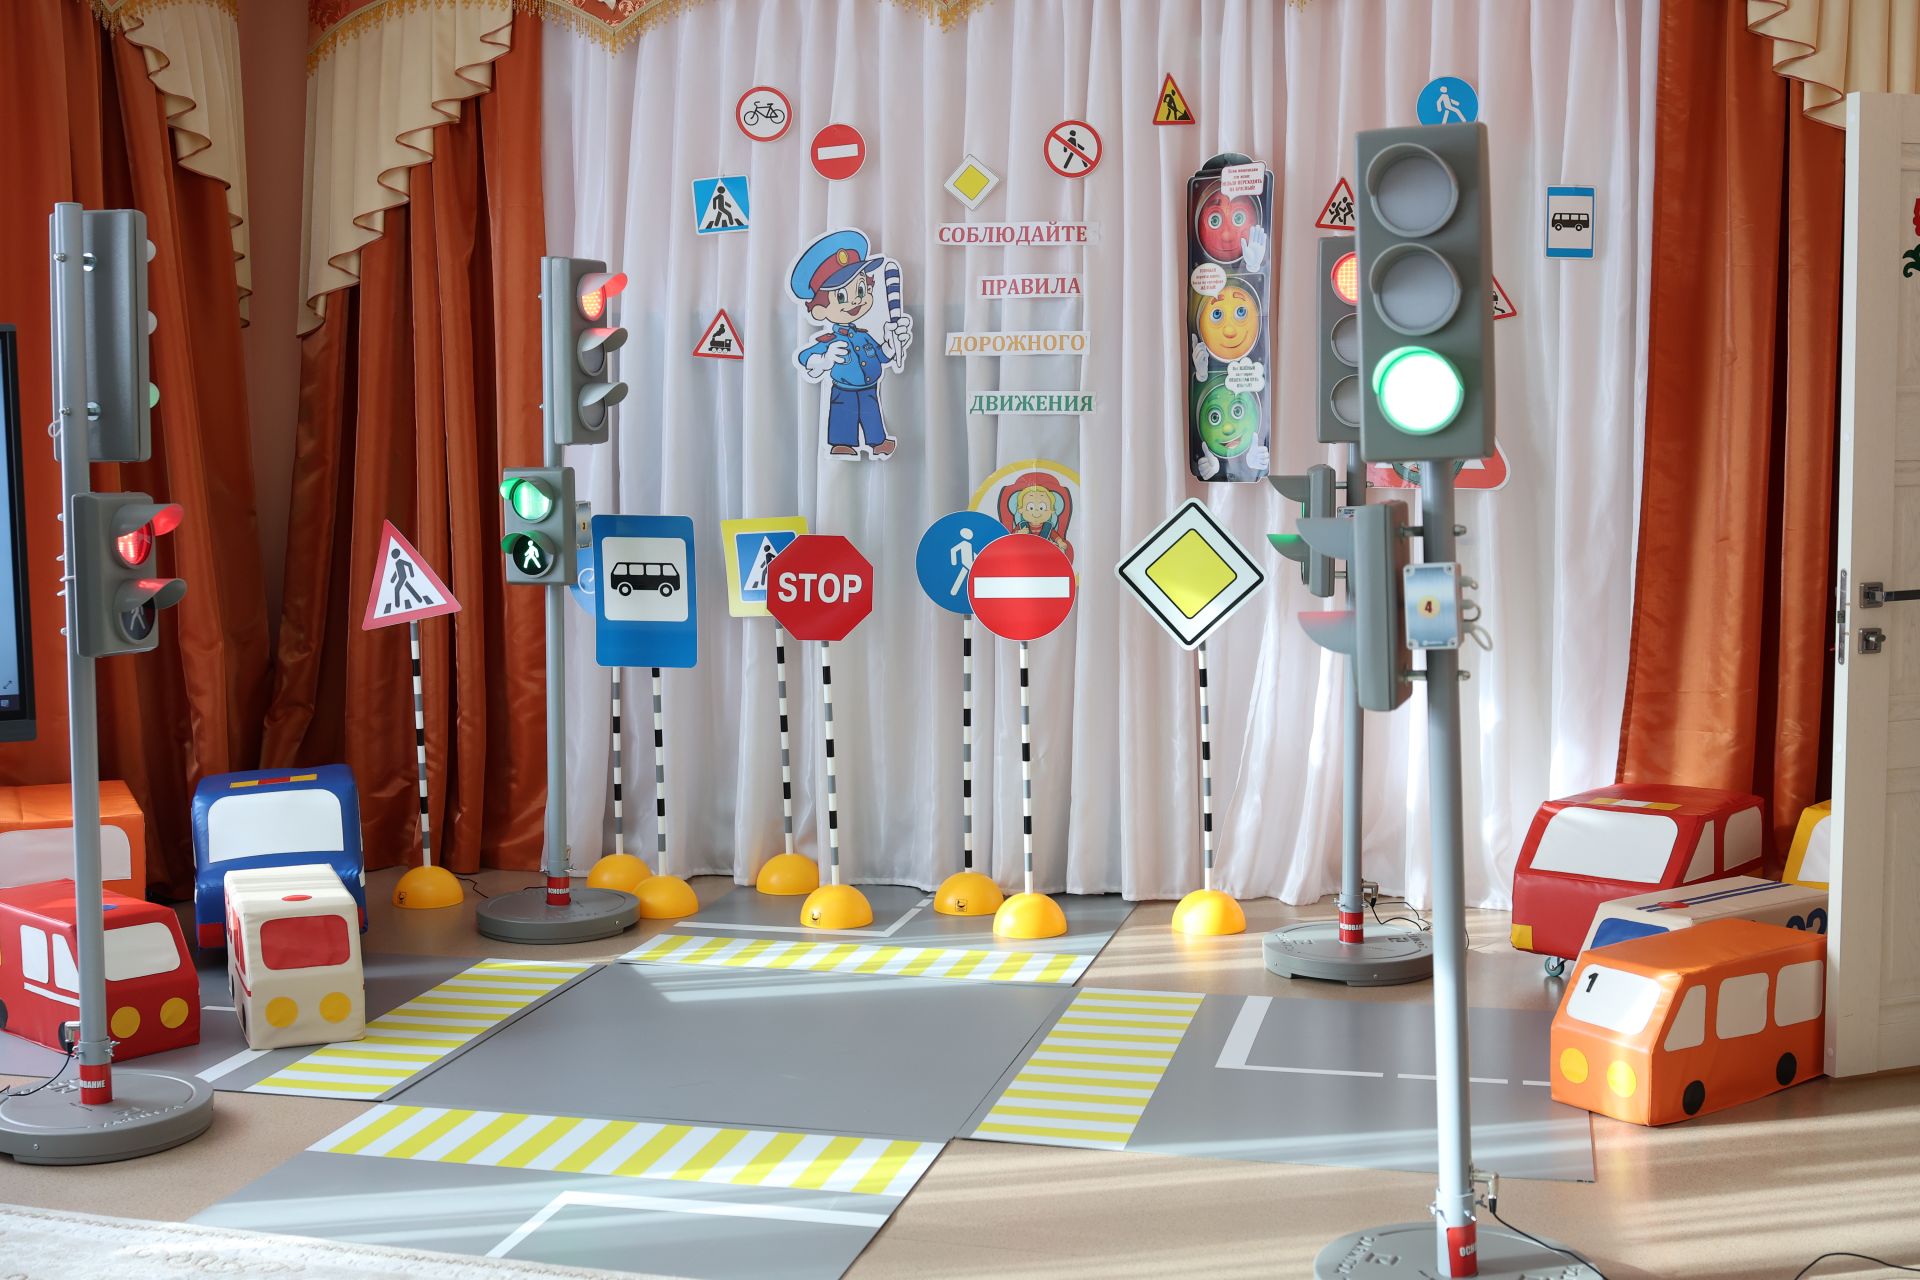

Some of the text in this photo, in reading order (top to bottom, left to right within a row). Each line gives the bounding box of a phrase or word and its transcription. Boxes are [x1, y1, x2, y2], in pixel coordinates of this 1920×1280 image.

[938, 221, 1088, 246] СОБЛЮДАЙТЕ
[981, 277, 1081, 296] ПРАВИЛА
[949, 334, 1085, 355] ДОРОЖНОГО
[969, 395, 1093, 415] ДВИЖЕНИЯ
[778, 571, 863, 604] STOP
[1424, 600, 1432, 613] 4
[1586, 972, 1599, 993] 1
[80, 1079, 106, 1089] ОВАНИЕ
